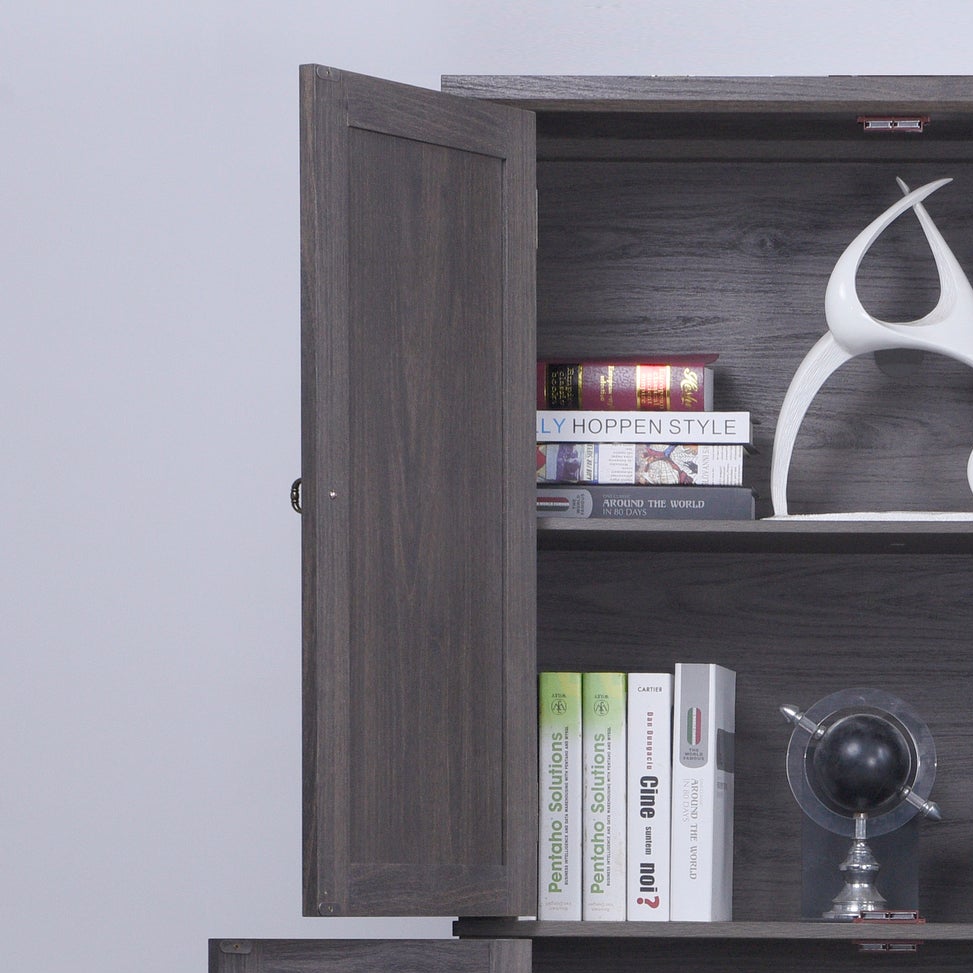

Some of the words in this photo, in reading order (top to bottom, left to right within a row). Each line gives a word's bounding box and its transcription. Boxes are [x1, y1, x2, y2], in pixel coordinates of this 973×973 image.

[536, 418, 566, 434] LY
[572, 418, 662, 435] HOPPEN
[669, 419, 737, 435] STYLE
[602, 499, 644, 508] AROUND
[648, 500, 666, 508] THE
[670, 500, 705, 509] WORLD
[625, 508, 647, 517] DAYS
[548, 732, 563, 812] Solutions
[591, 733, 605, 813] Solutions
[640, 775, 658, 818] Cine
[548, 820, 562, 893] Pentaho
[591, 820, 605, 894] Pentaho
